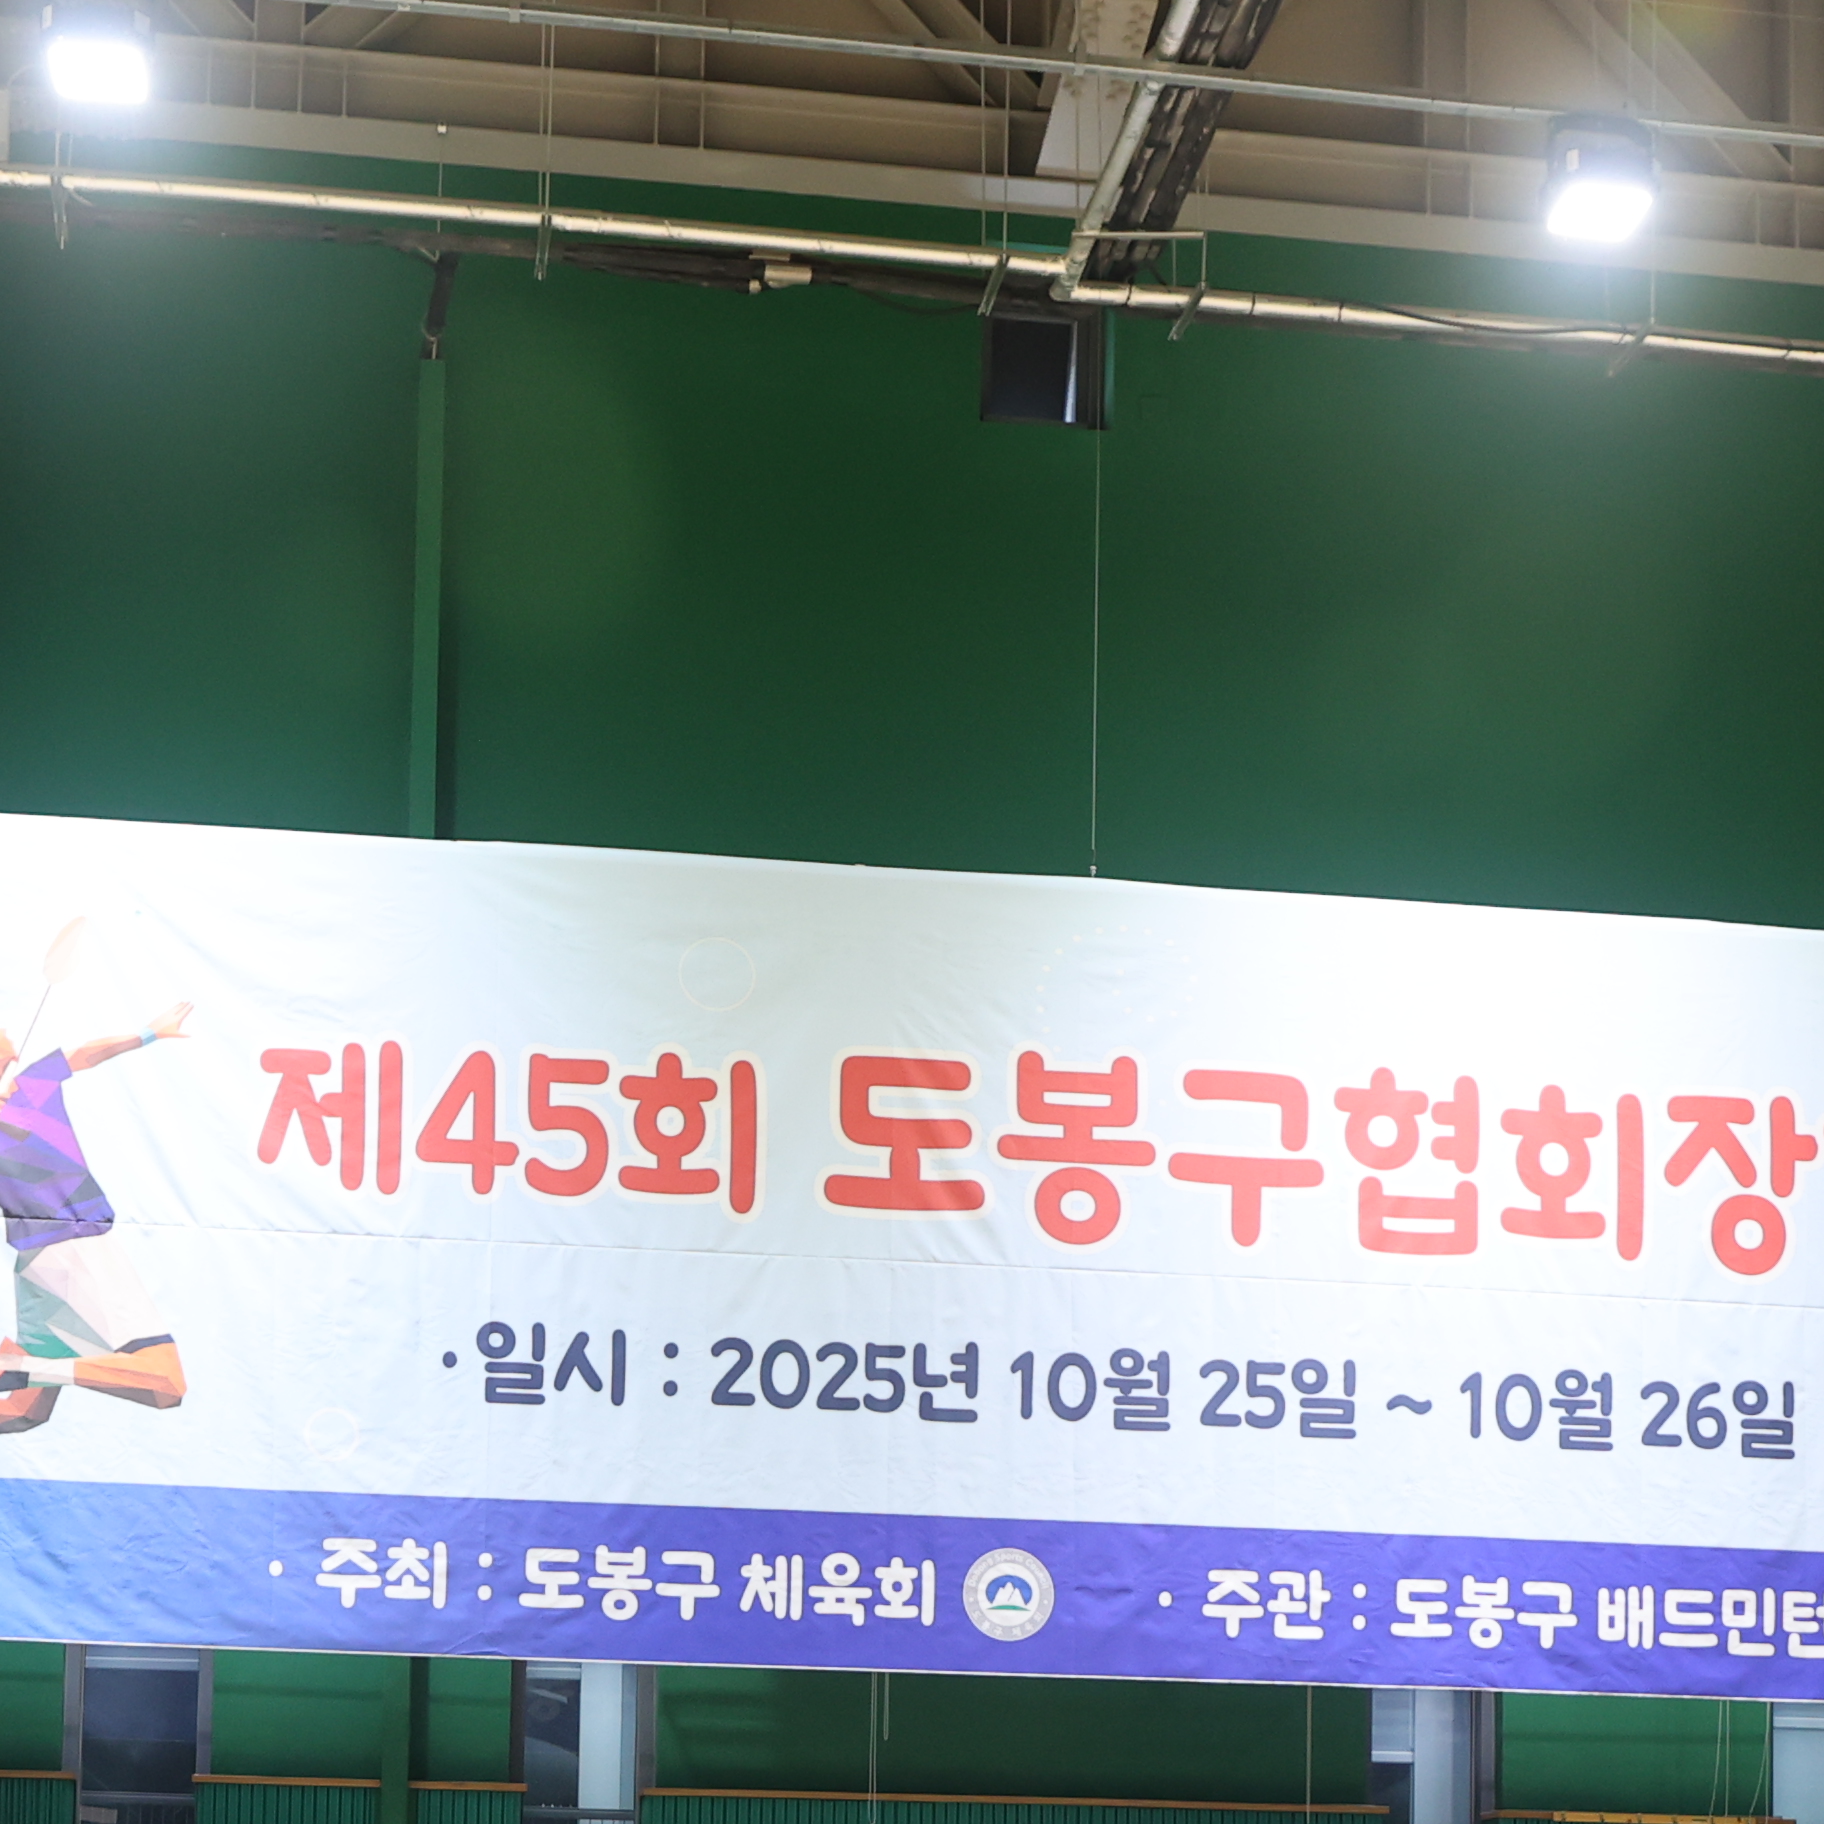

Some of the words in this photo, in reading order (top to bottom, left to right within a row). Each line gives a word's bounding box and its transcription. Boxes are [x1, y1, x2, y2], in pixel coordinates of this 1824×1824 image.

[256, 1040, 757, 1214] 제45회
[711, 1337, 978, 1423] 2025년
[1010, 1348, 1171, 1431] 10월
[1199, 1358, 1357, 1440] 25일
[1459, 1369, 1614, 1451] 10월
[1641, 1380, 1796, 1460] 26일
[315, 1537, 448, 1610] 주최
[519, 1544, 721, 1621] 도봉구
[739, 1551, 936, 1627] 체육회
[1201, 1569, 1331, 1640] 주관
[1389, 1574, 1578, 1649] 도봉구
